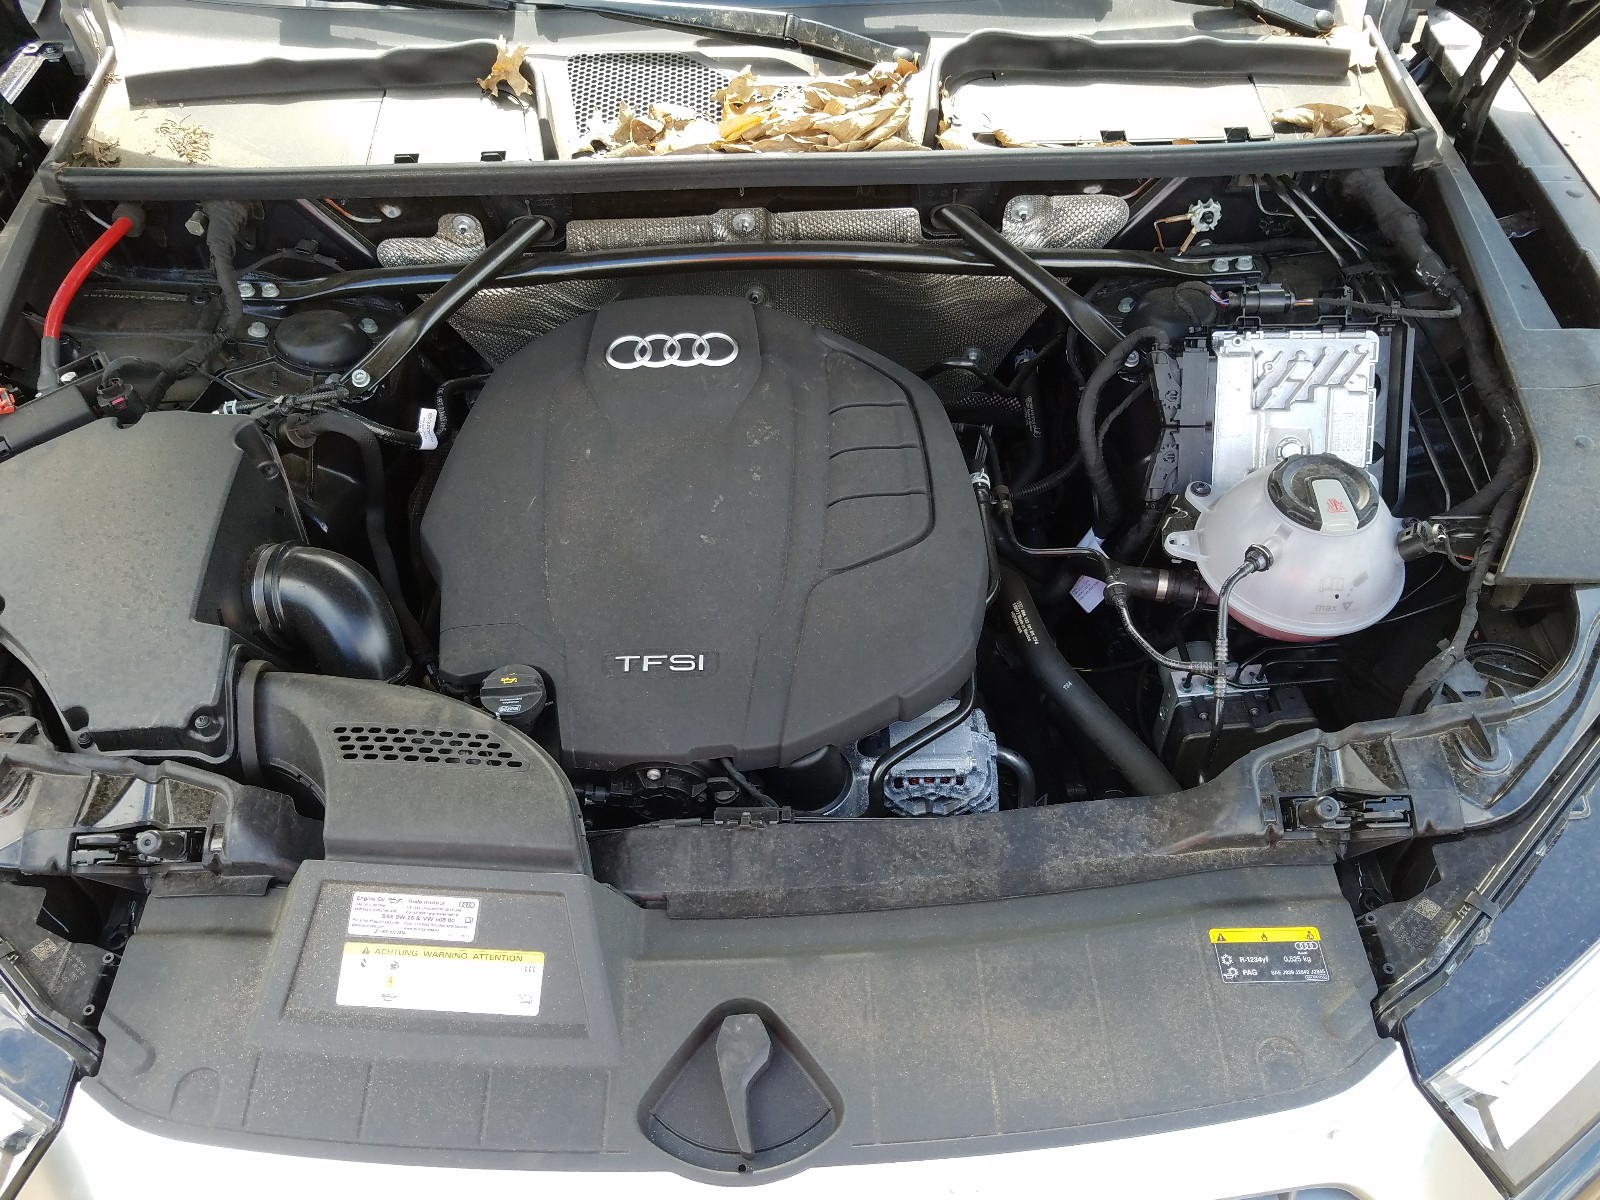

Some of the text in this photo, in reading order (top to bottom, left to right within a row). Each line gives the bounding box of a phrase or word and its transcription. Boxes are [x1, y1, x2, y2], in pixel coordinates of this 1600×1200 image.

[1315, 604, 1337, 612] max
[615, 654, 704, 672] TFSI
[374, 948, 523, 963] ACHTUNG WARNING ATTENTION
[1239, 956, 1269, 964] R-1234yf
